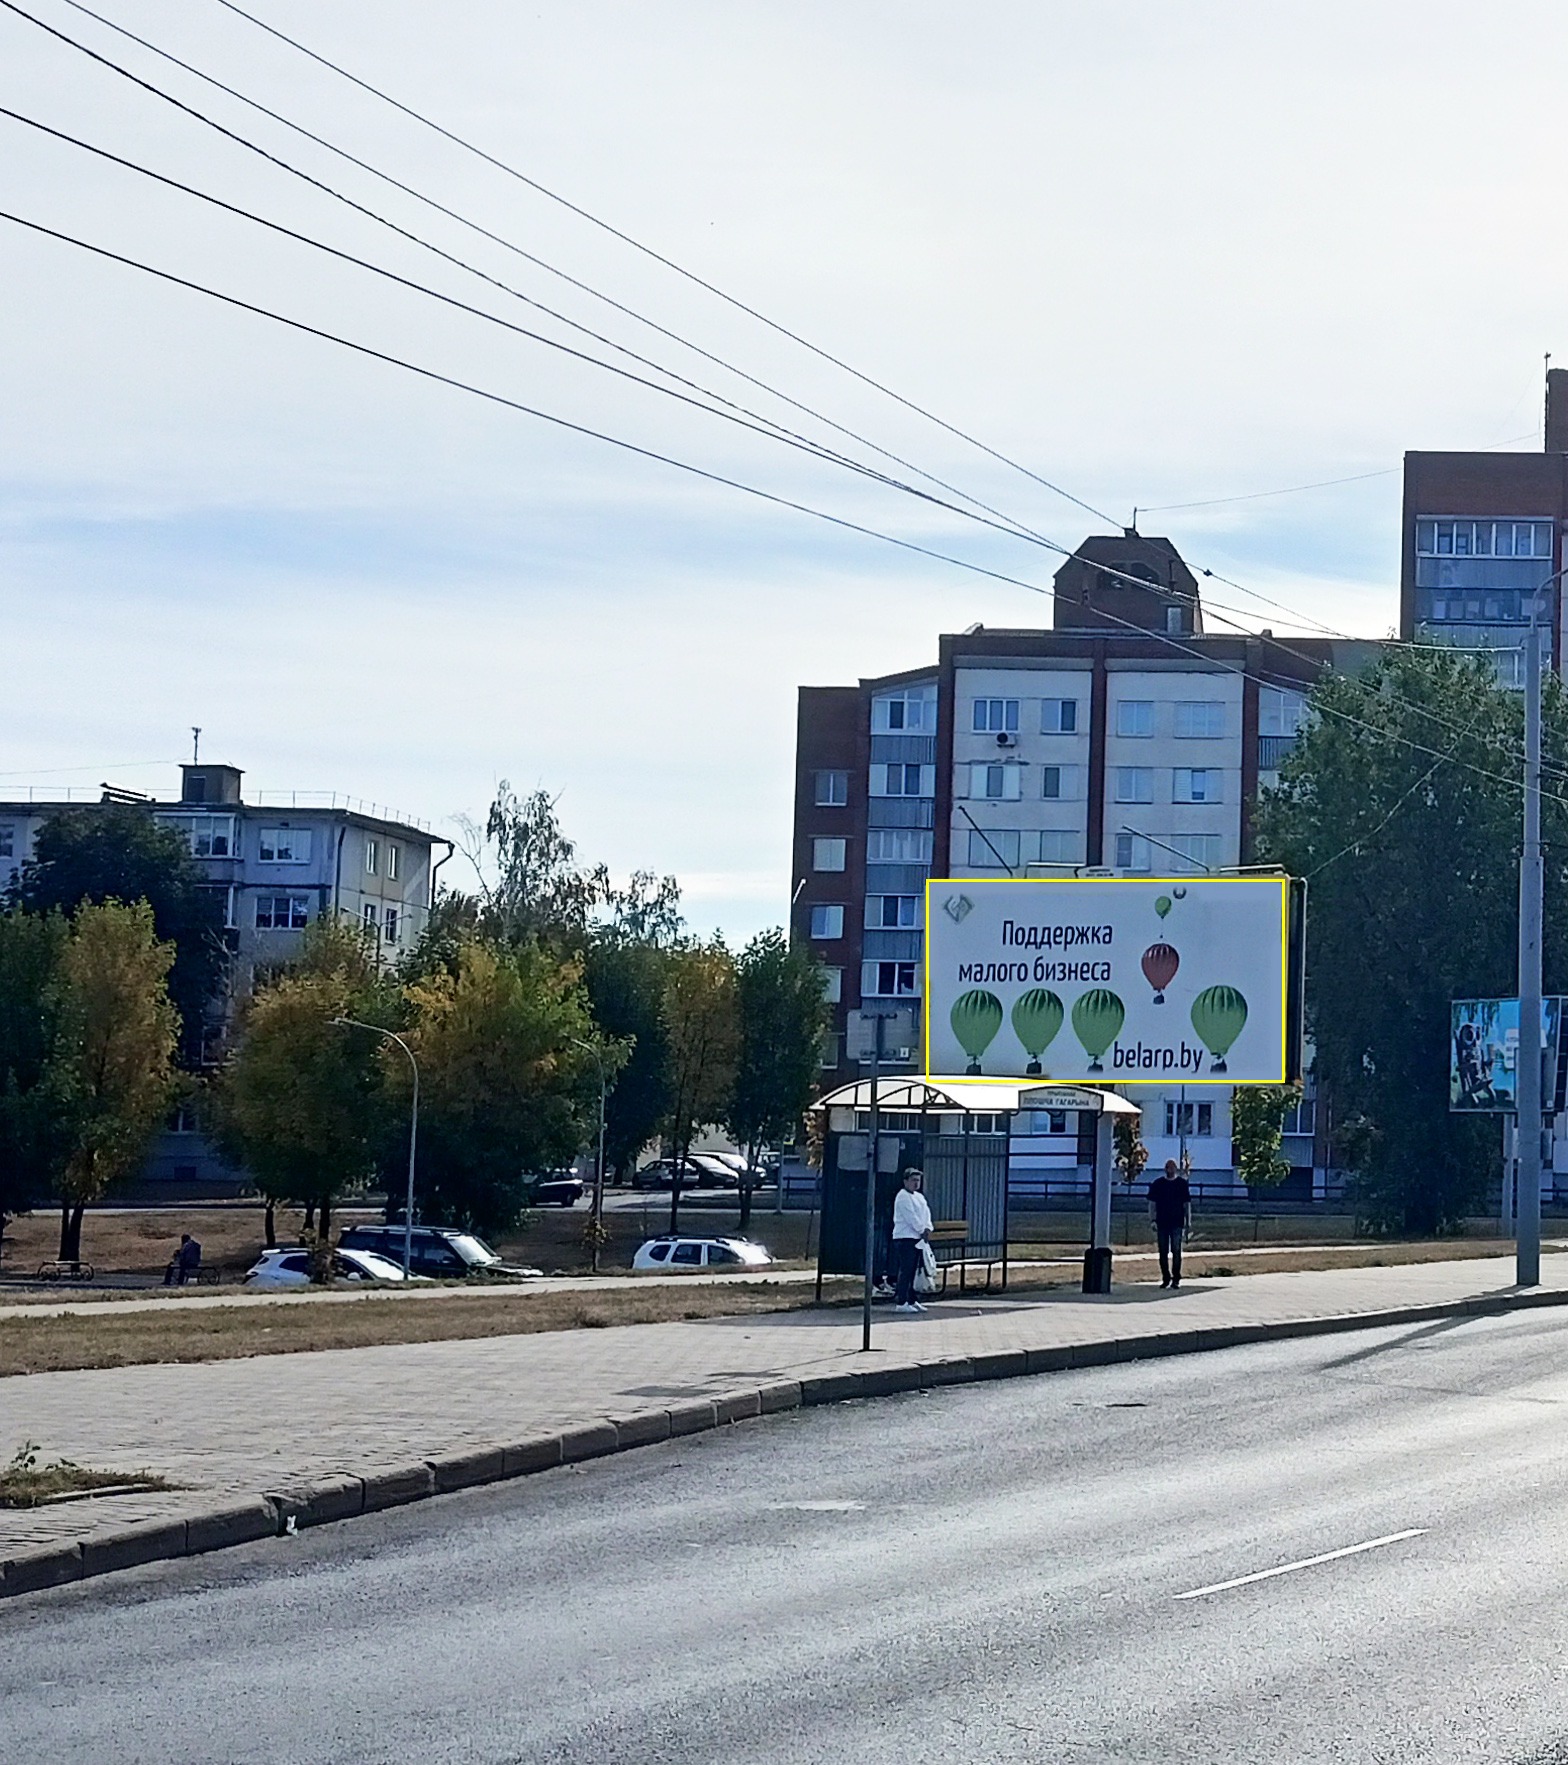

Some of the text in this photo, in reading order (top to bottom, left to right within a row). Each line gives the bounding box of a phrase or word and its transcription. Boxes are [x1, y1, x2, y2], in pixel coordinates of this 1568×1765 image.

[1003, 920, 1113, 951] Поддержка
[958, 956, 1111, 982] малого бизнеса
[1113, 1041, 1203, 1074] belarp.by
